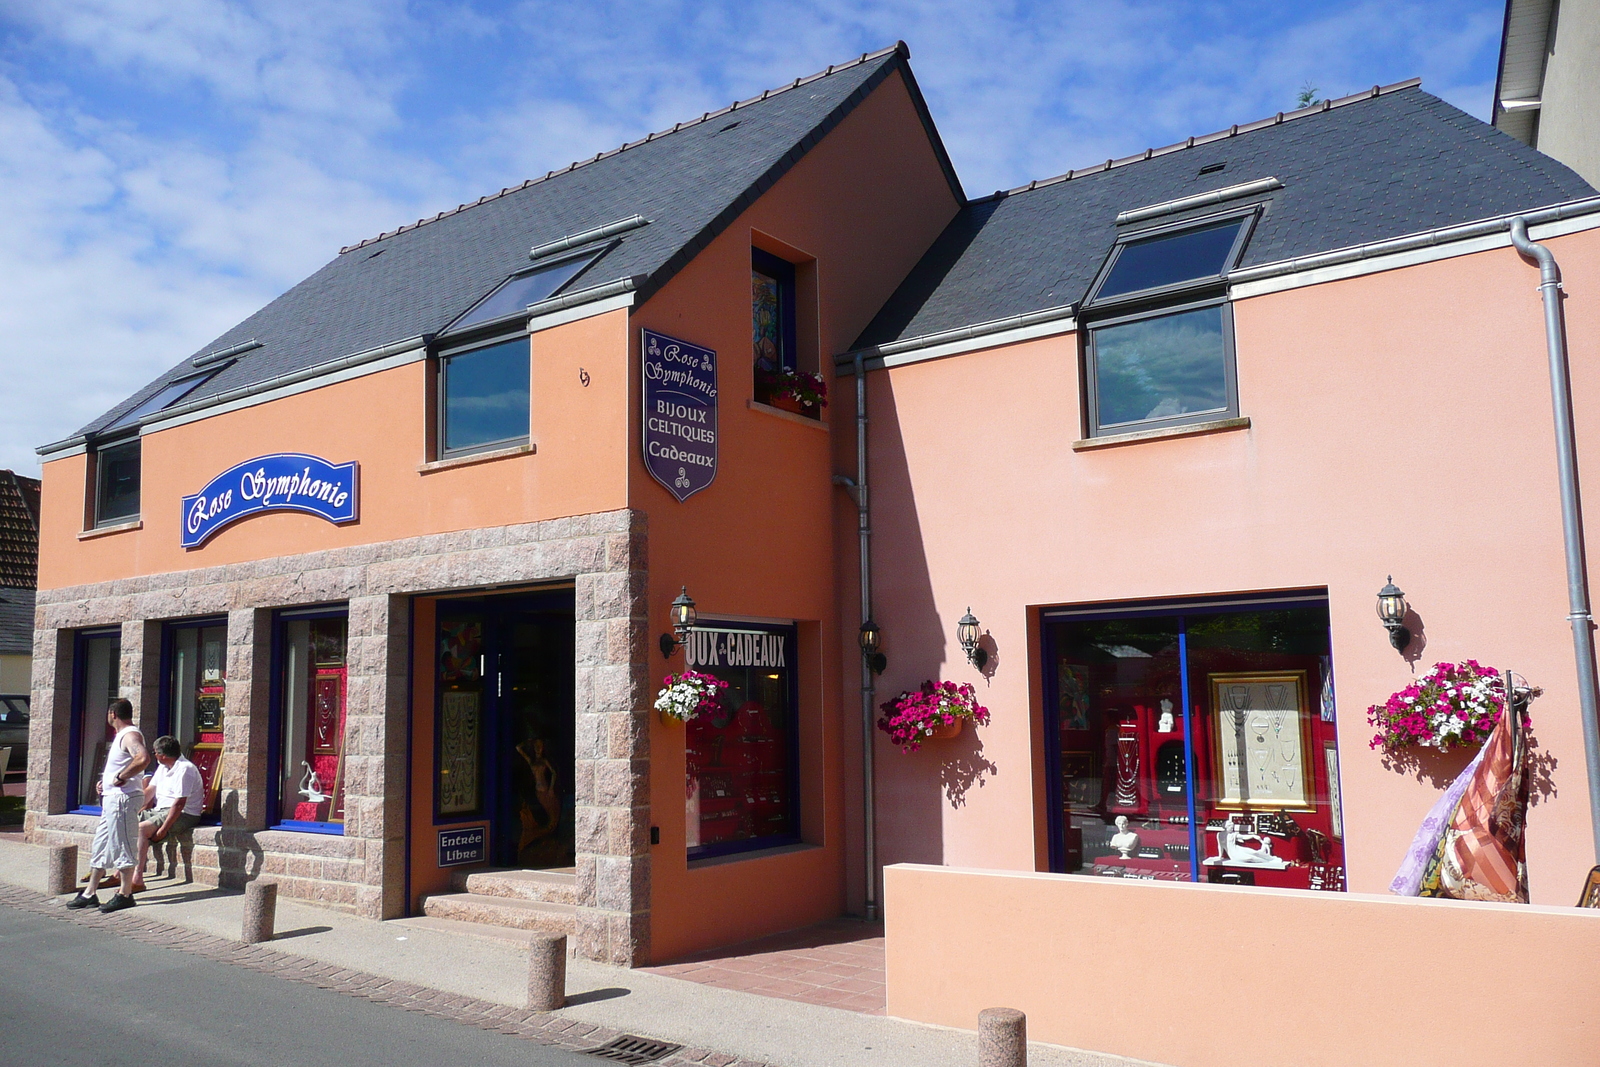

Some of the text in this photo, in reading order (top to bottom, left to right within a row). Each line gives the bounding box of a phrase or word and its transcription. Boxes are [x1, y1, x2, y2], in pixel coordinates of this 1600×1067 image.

[664, 344, 699, 368] Rose
[645, 361, 717, 398] Symphonie
[657, 399, 707, 424] BIJOUX
[648, 417, 715, 444] CELTIQUES
[649, 440, 714, 468] Cadeaux
[187, 466, 349, 534] Rose Symphonie
[726, 632, 786, 668] CADEAUX
[441, 833, 482, 847] Entrée
[446, 849, 477, 861] Libre
